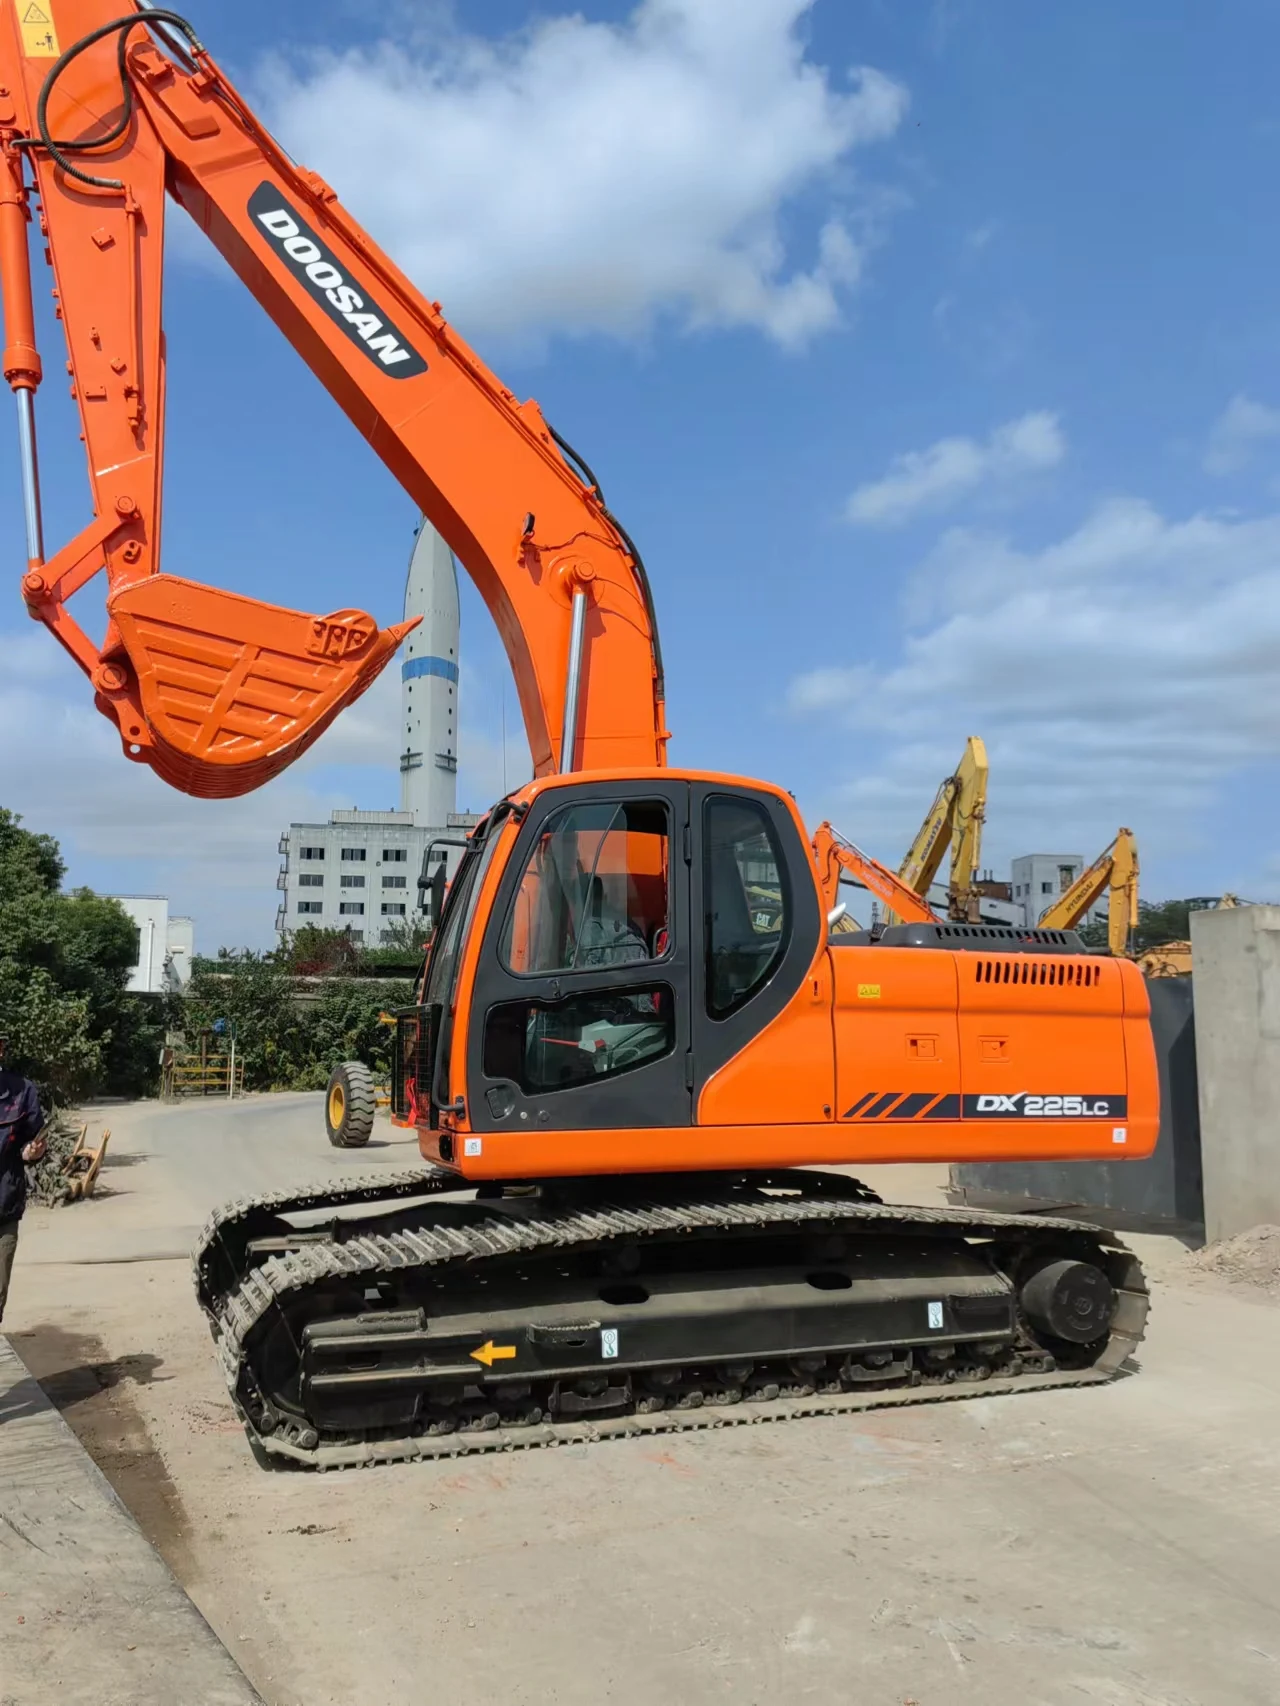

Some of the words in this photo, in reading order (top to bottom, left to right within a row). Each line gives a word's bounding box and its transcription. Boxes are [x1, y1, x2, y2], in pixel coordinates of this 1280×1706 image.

[257, 209, 411, 366] DOOSAN
[921, 818, 942, 862] KOMATSU
[1066, 881, 1094, 913] HYUNDAI
[756, 912, 771, 927] CAT
